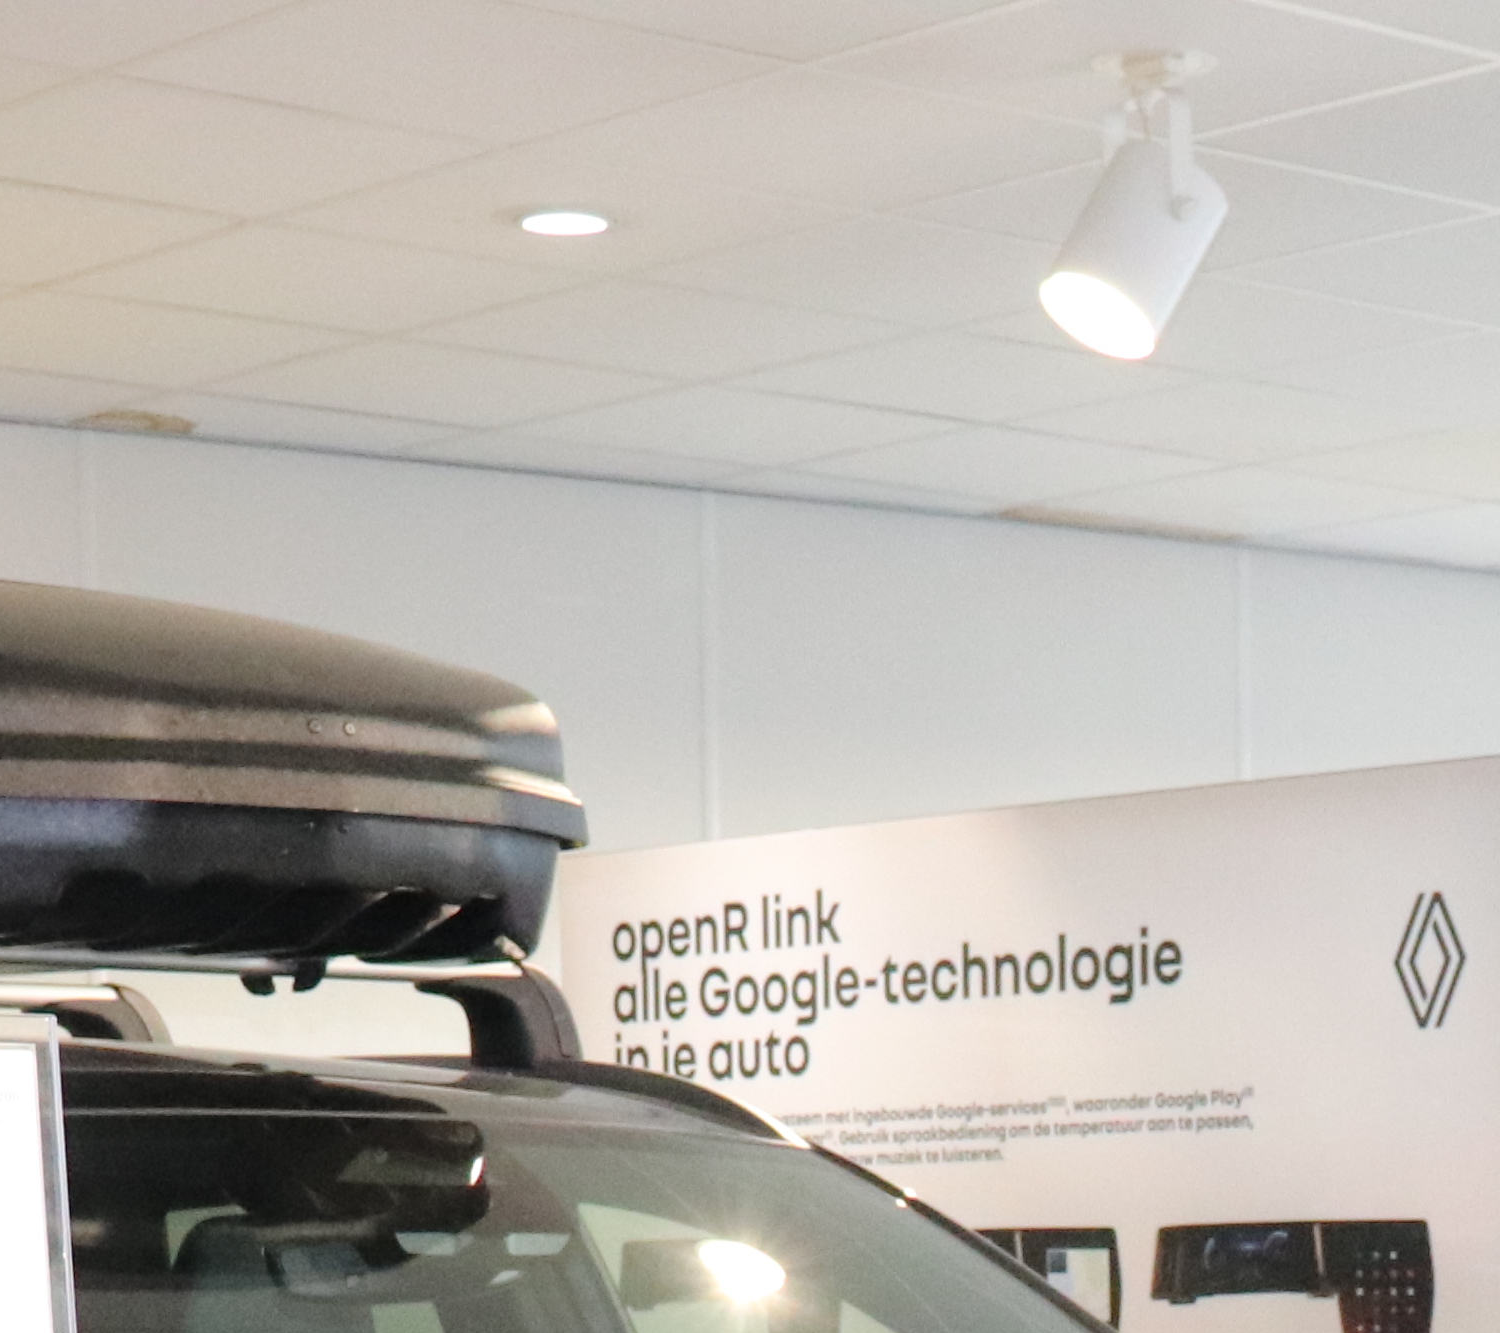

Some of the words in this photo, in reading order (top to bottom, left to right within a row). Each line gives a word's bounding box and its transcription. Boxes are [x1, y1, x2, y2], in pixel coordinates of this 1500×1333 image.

[613, 902, 748, 975] openR
[762, 889, 841, 949] link
[614, 967, 687, 1023] alle
[699, 926, 1183, 1026] Google-technologie
[708, 1031, 810, 1080] auto
[1073, 1095, 1152, 1113] waaronder
[1155, 1090, 1207, 1111] Google
[840, 1129, 888, 1146] Gebruik
[892, 1125, 1006, 1144] spraakbediening
[1010, 1125, 1030, 1138] om
[1034, 1122, 1051, 1137] de
[1054, 1119, 1145, 1138] temperatuur
[1147, 1118, 1176, 1132] aan
[1178, 1116, 1194, 1131] te
[1196, 1115, 1254, 1139] passen,
[926, 1150, 939, 1163] te
[942, 1147, 1004, 1163] luisteren.
